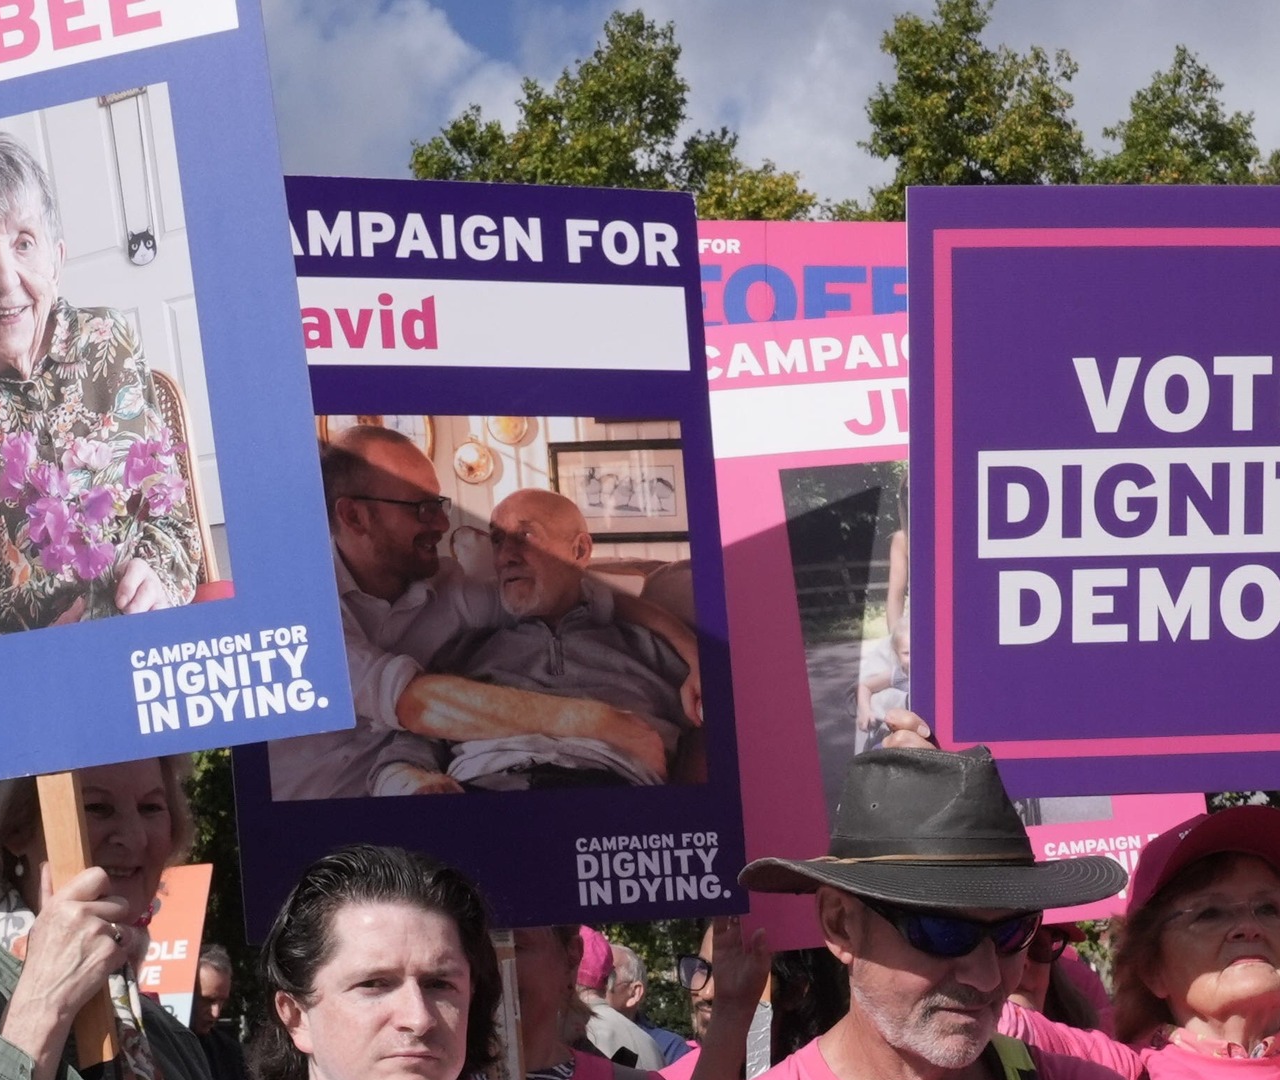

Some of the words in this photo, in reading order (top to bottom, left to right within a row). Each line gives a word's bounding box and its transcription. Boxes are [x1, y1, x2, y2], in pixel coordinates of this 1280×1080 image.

[565, 218, 680, 267] FOR
[698, 239, 741, 254] FOR
[705, 333, 908, 380] CAMPAI
[130, 633, 252, 669] CAMPAIGN
[259, 625, 308, 649] FOR
[133, 644, 309, 702] DIGNITY
[137, 698, 180, 735] IN
[186, 679, 329, 727] DYING.
[575, 833, 675, 852] CAMPAIGN
[681, 832, 718, 847] FOR
[1044, 835, 1141, 857] CAMPAIGN
[576, 848, 719, 880] DIGNITY
[578, 880, 613, 906] IN
[619, 874, 732, 904] DYING.
